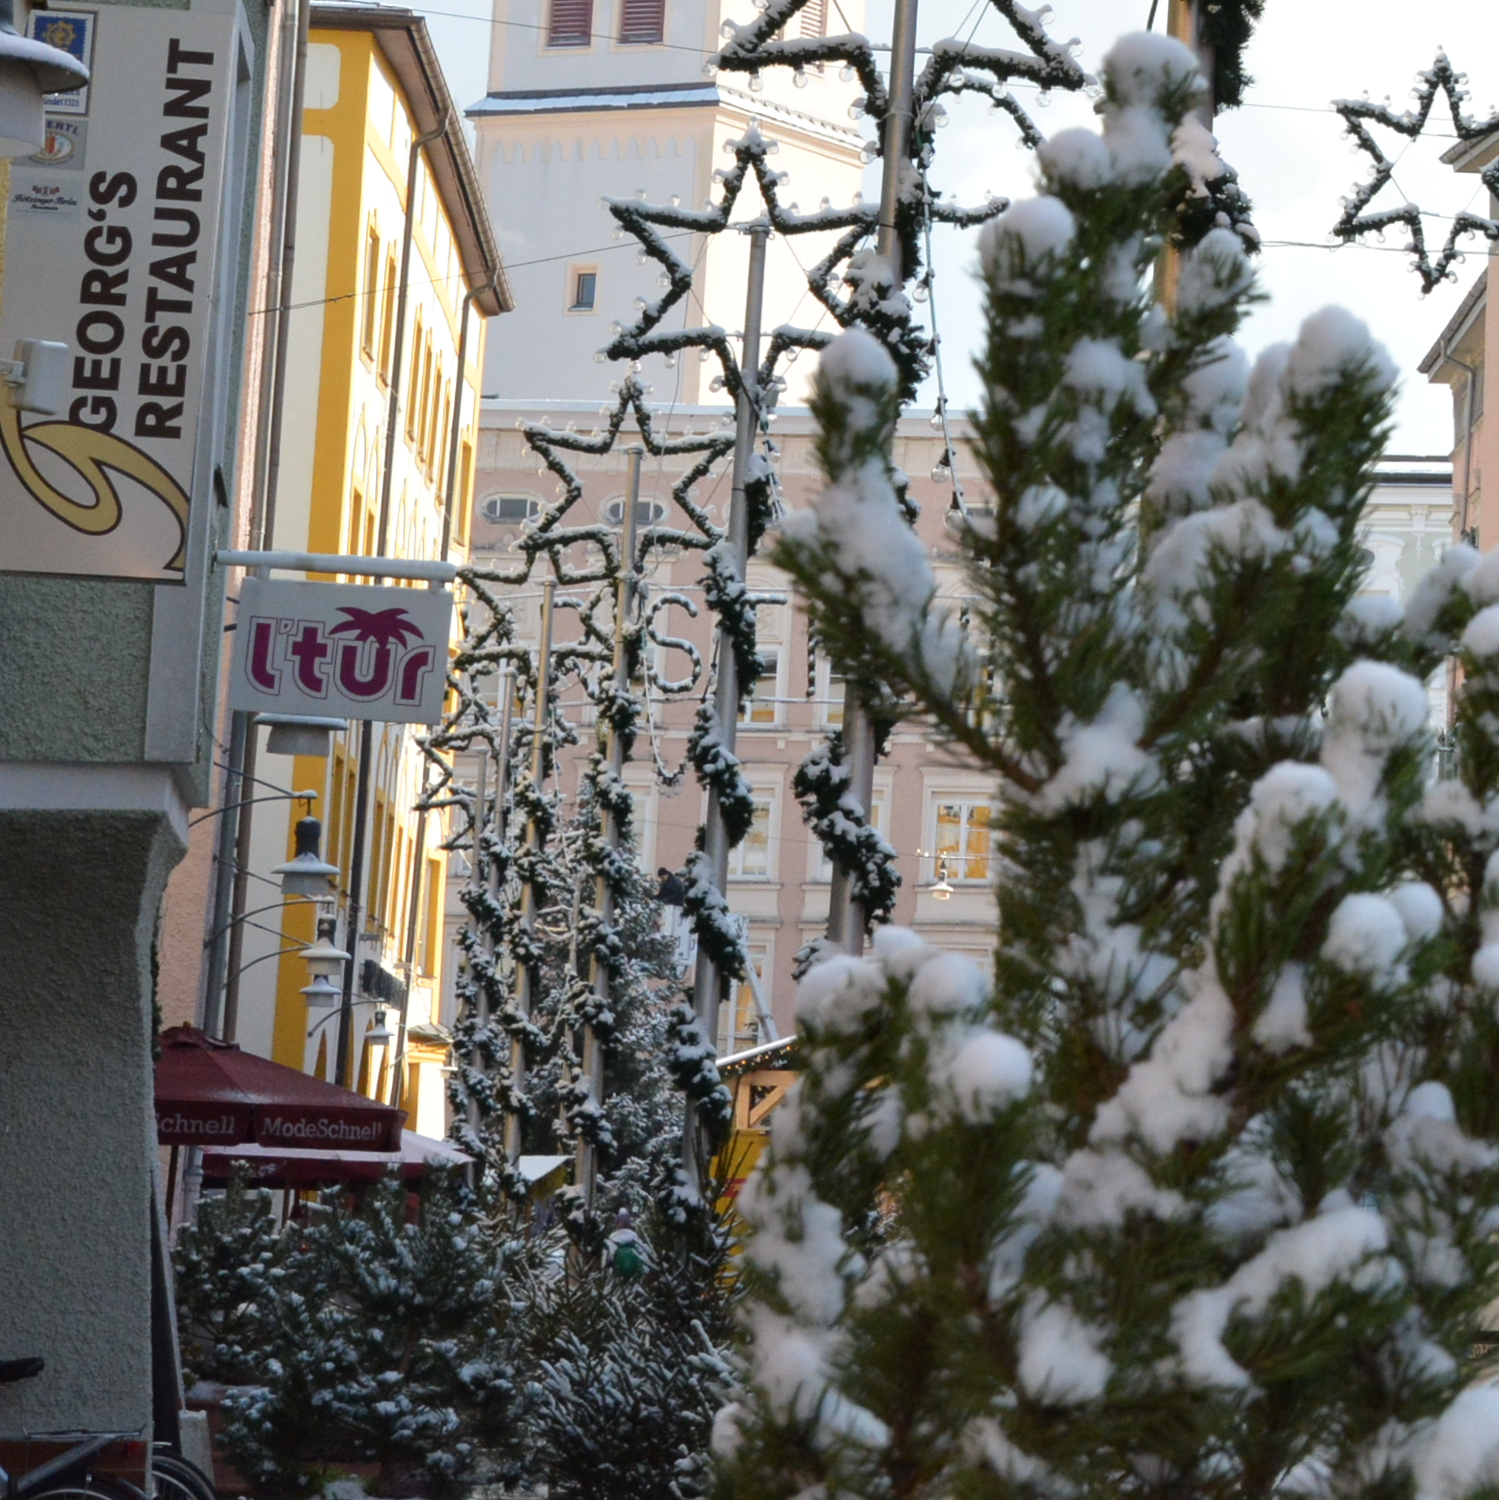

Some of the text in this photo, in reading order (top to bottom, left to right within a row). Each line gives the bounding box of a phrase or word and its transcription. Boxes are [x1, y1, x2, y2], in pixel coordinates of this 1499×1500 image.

[46, 120, 80, 135] ERTL
[134, 38, 214, 439] RESTAURANT
[155, 1113, 235, 1135] chnell
